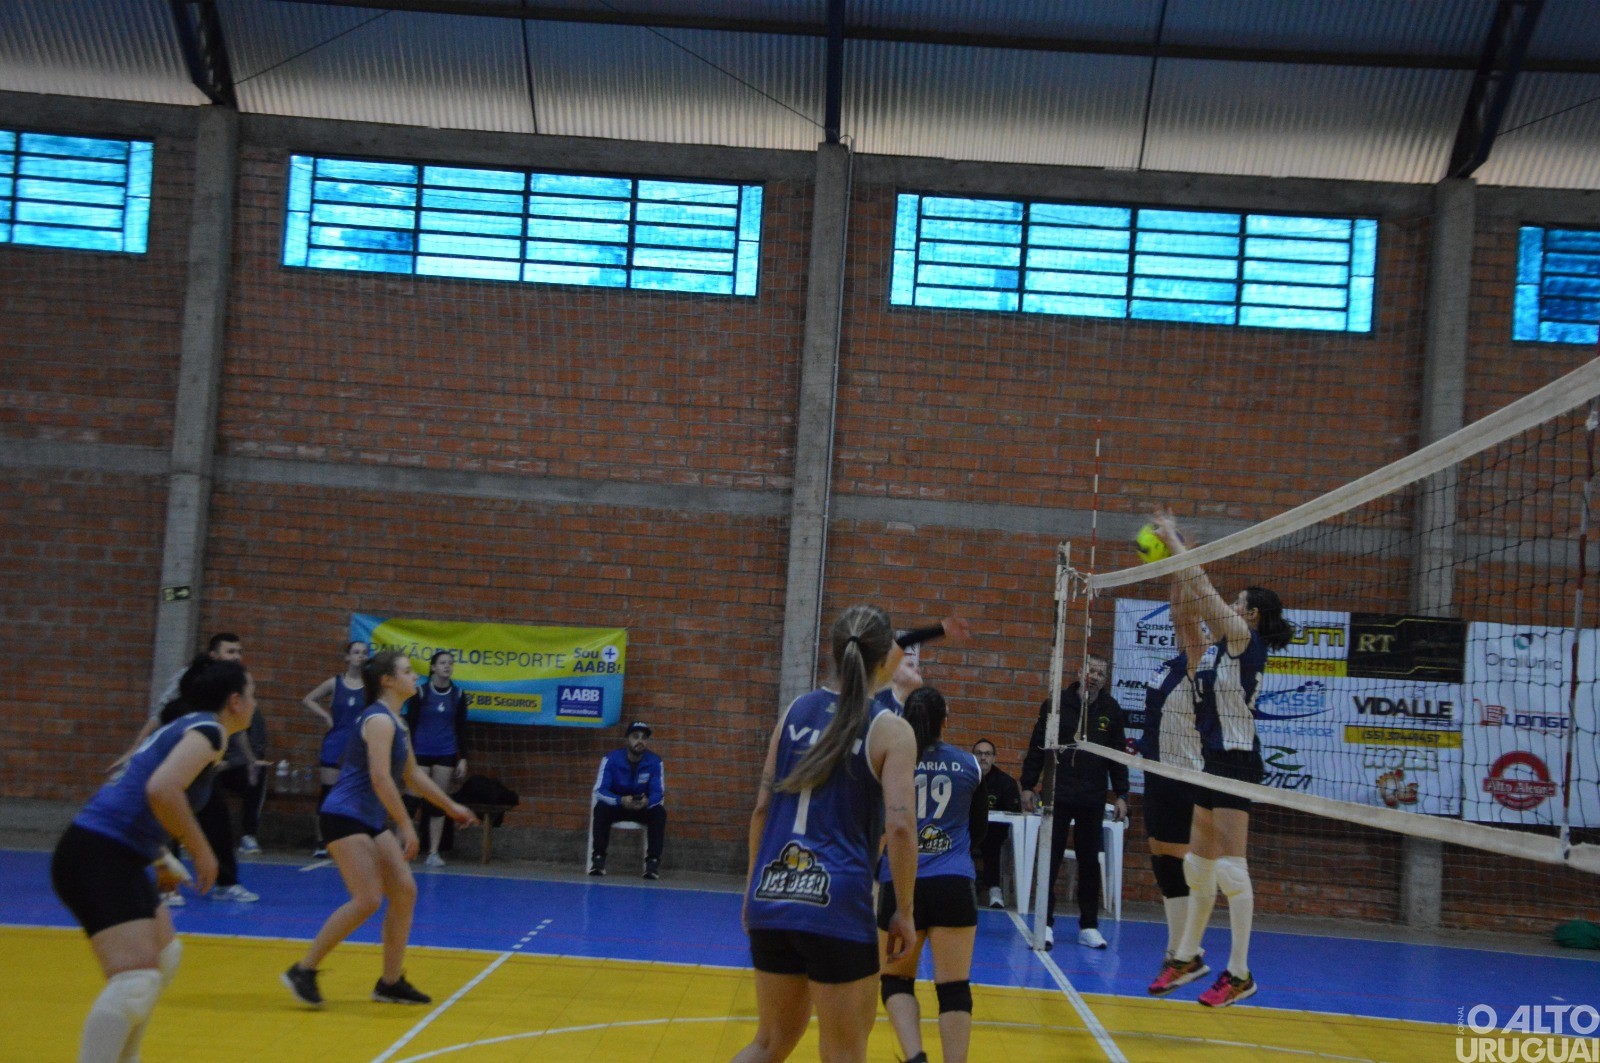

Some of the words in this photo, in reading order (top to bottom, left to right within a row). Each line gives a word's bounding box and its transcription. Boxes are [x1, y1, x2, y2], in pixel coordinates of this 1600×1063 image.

[1135, 630, 1176, 647] Frei
[1355, 633, 1395, 653] RT
[573, 647, 599, 659] Sou
[573, 661, 621, 675] AABB!
[560, 688, 600, 702] AABB
[1352, 696, 1454, 719] VIDALLE
[951, 762, 964, 773] D.
[914, 773, 953, 819] 19
